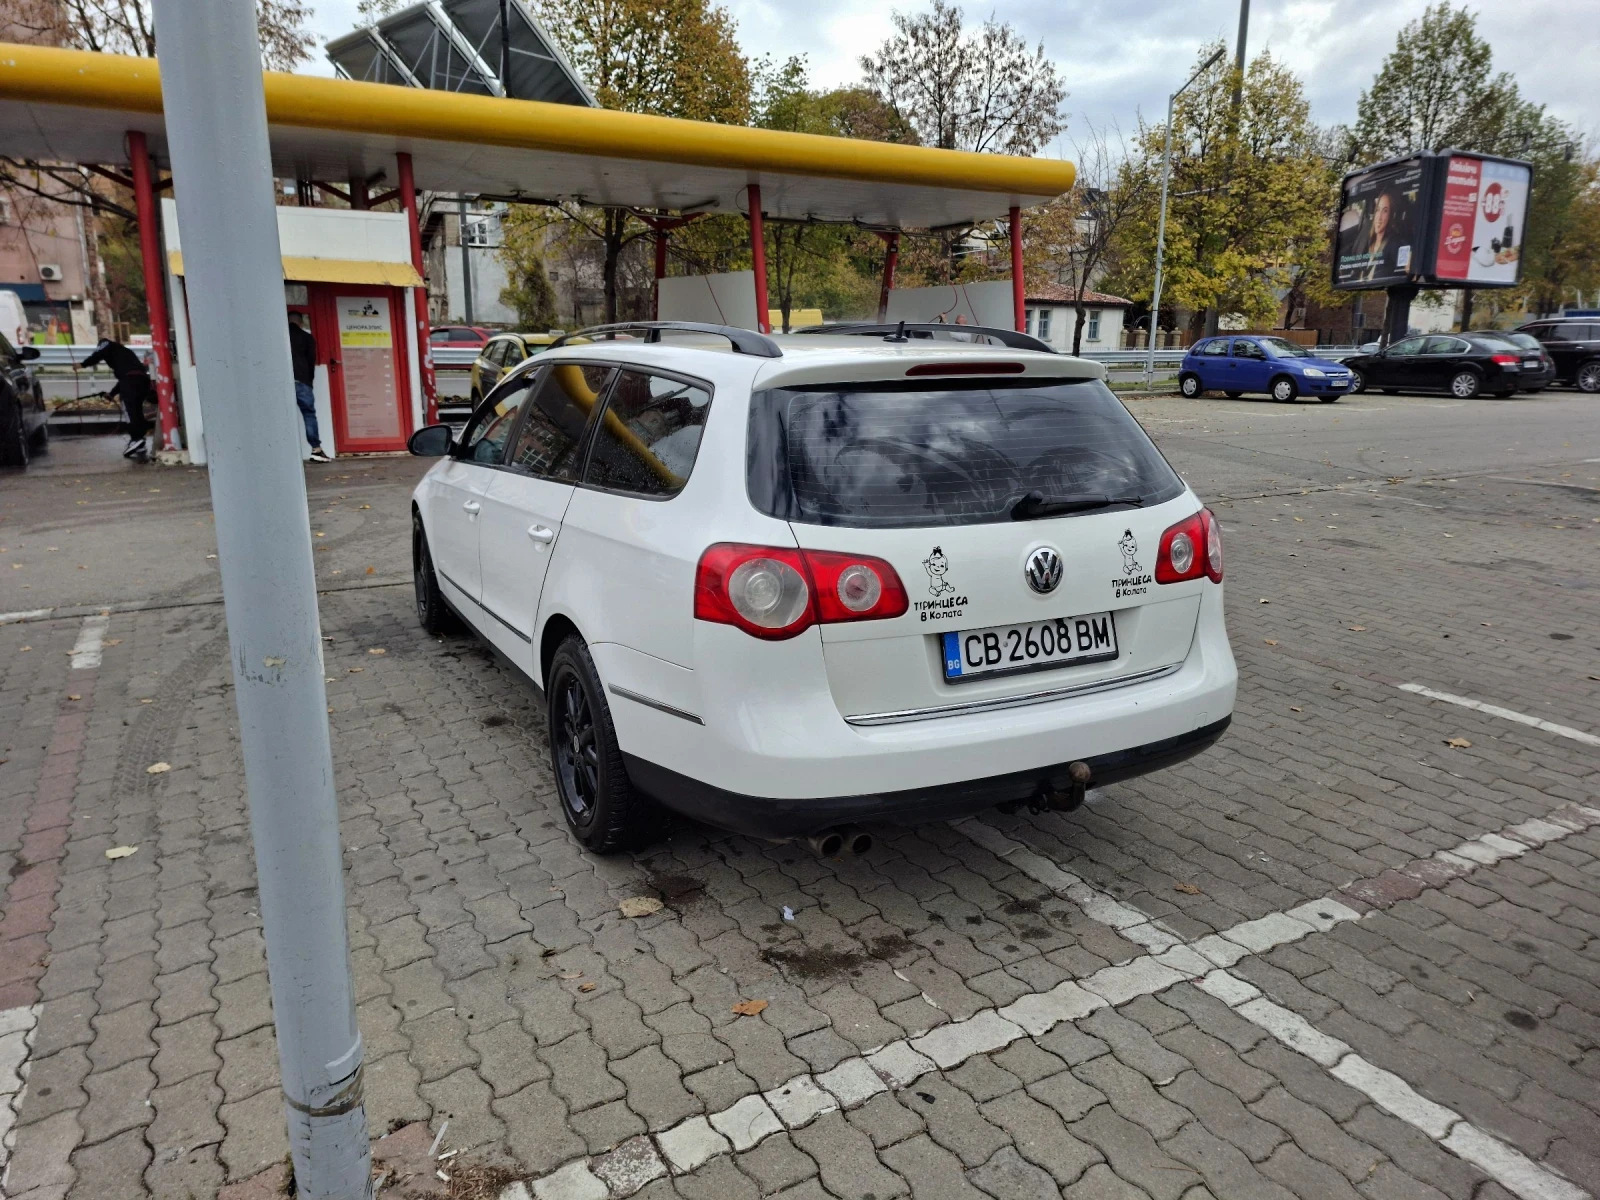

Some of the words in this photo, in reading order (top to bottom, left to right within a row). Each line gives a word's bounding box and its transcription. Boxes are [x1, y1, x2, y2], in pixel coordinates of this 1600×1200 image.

[1121, 586, 1147, 597] Колата
[929, 609, 963, 620] Колата
[1007, 622, 1072, 662] 2608
[947, 659, 960, 670] BG
